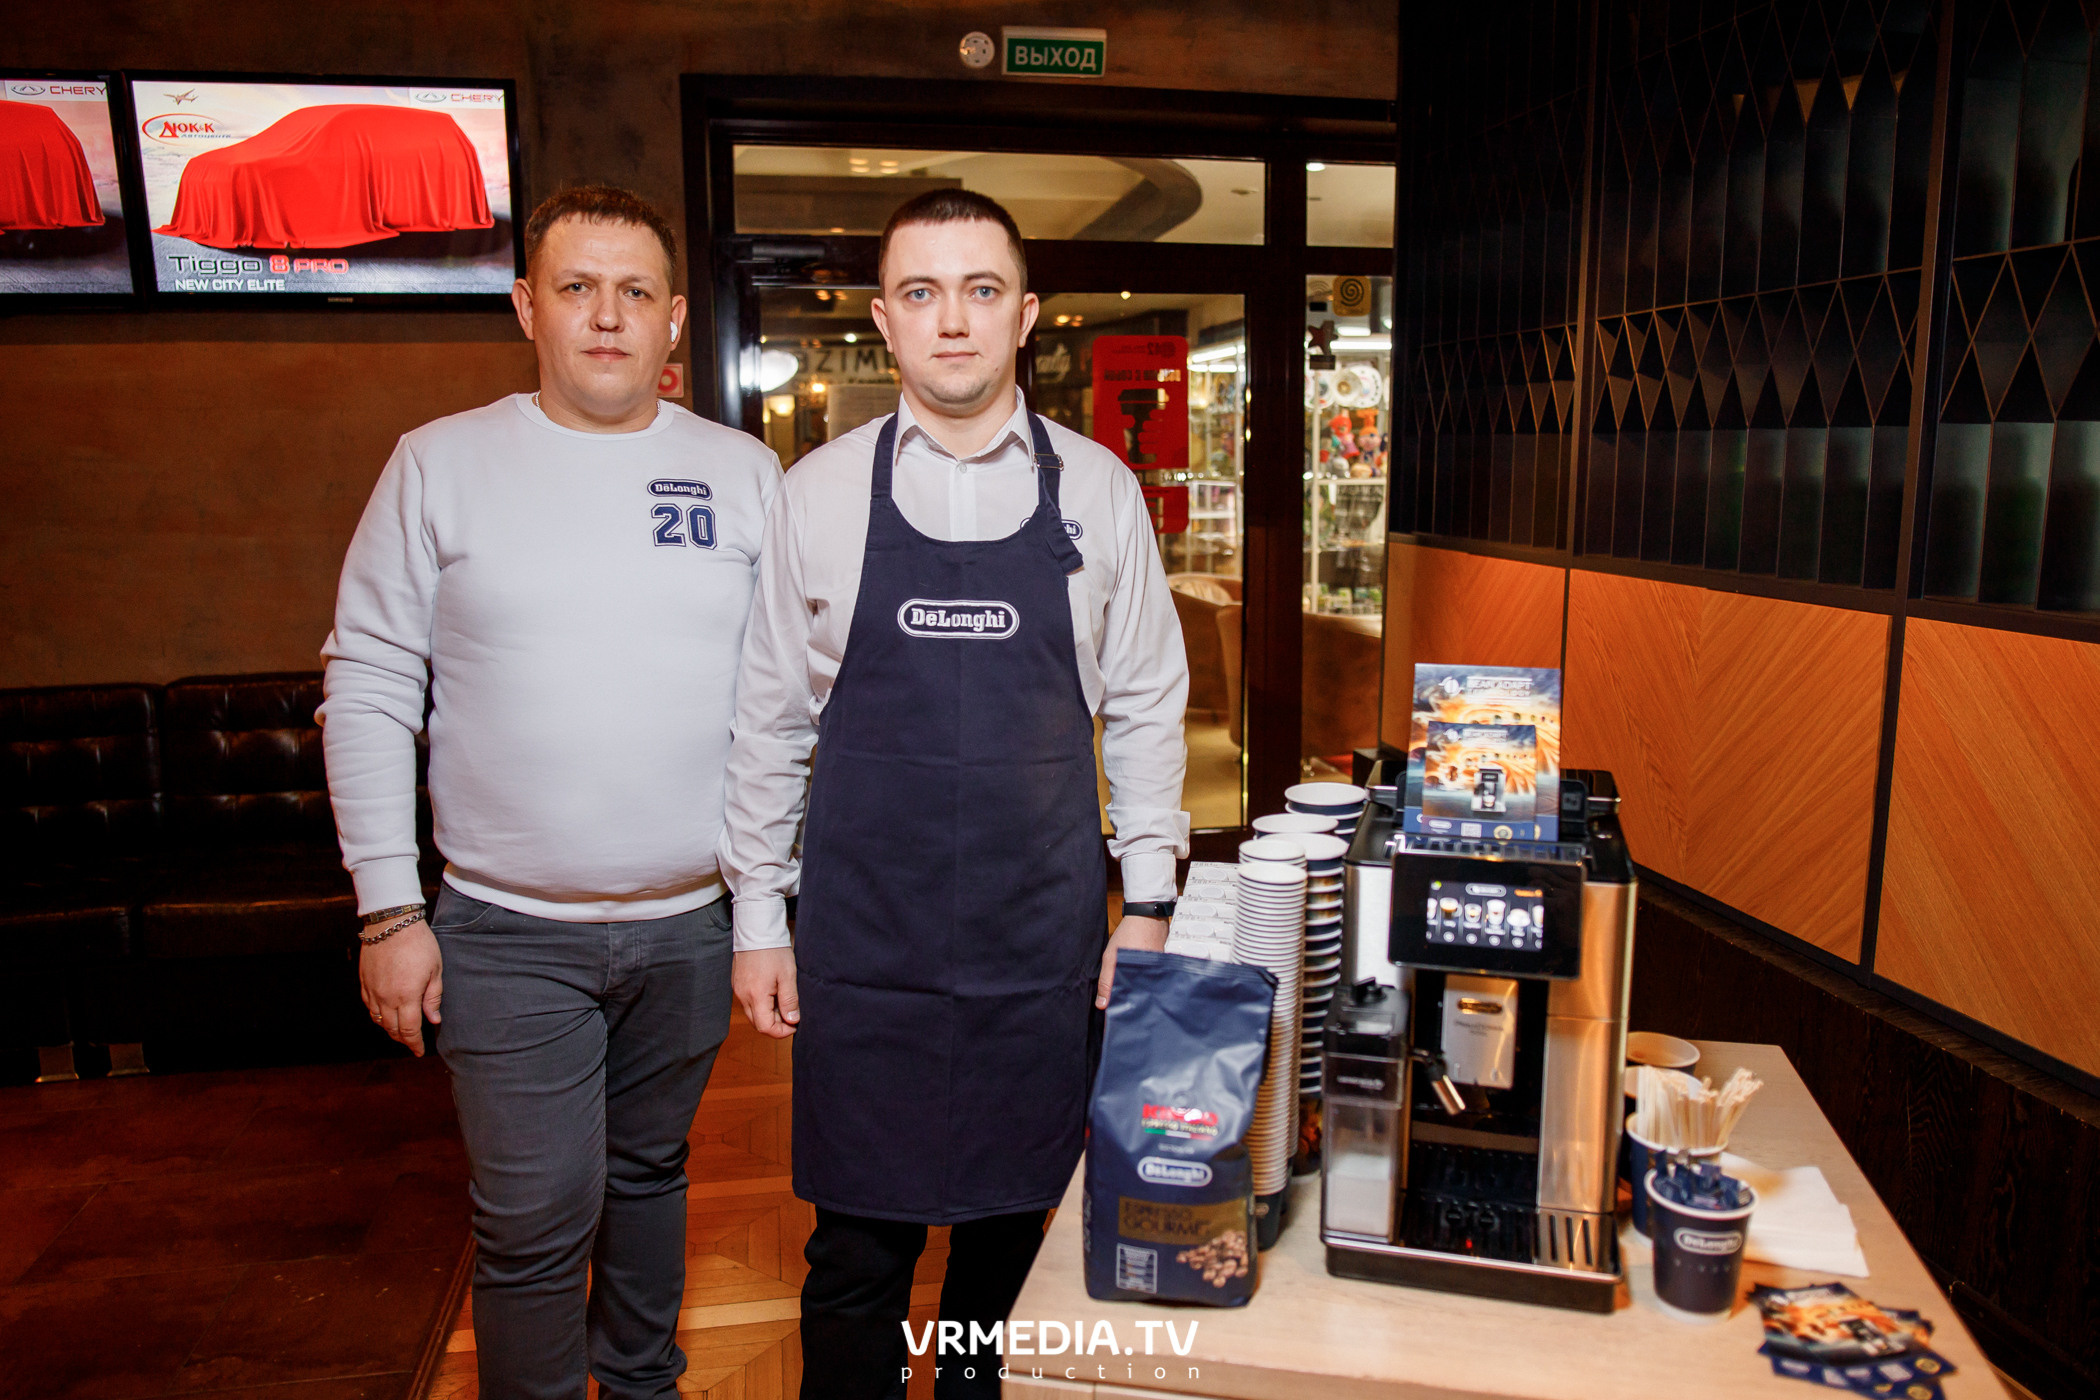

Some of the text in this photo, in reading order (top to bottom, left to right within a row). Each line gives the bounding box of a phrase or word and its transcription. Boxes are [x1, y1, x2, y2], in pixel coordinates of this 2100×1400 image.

[1014, 45, 1096, 71] ВЫХОД
[50, 85, 107, 95] CHERY
[451, 93, 504, 103] CHERY
[168, 254, 350, 276] Tiggo 8 PRO
[175, 279, 286, 291] NEW CITY ELITE
[650, 503, 718, 550] 20
